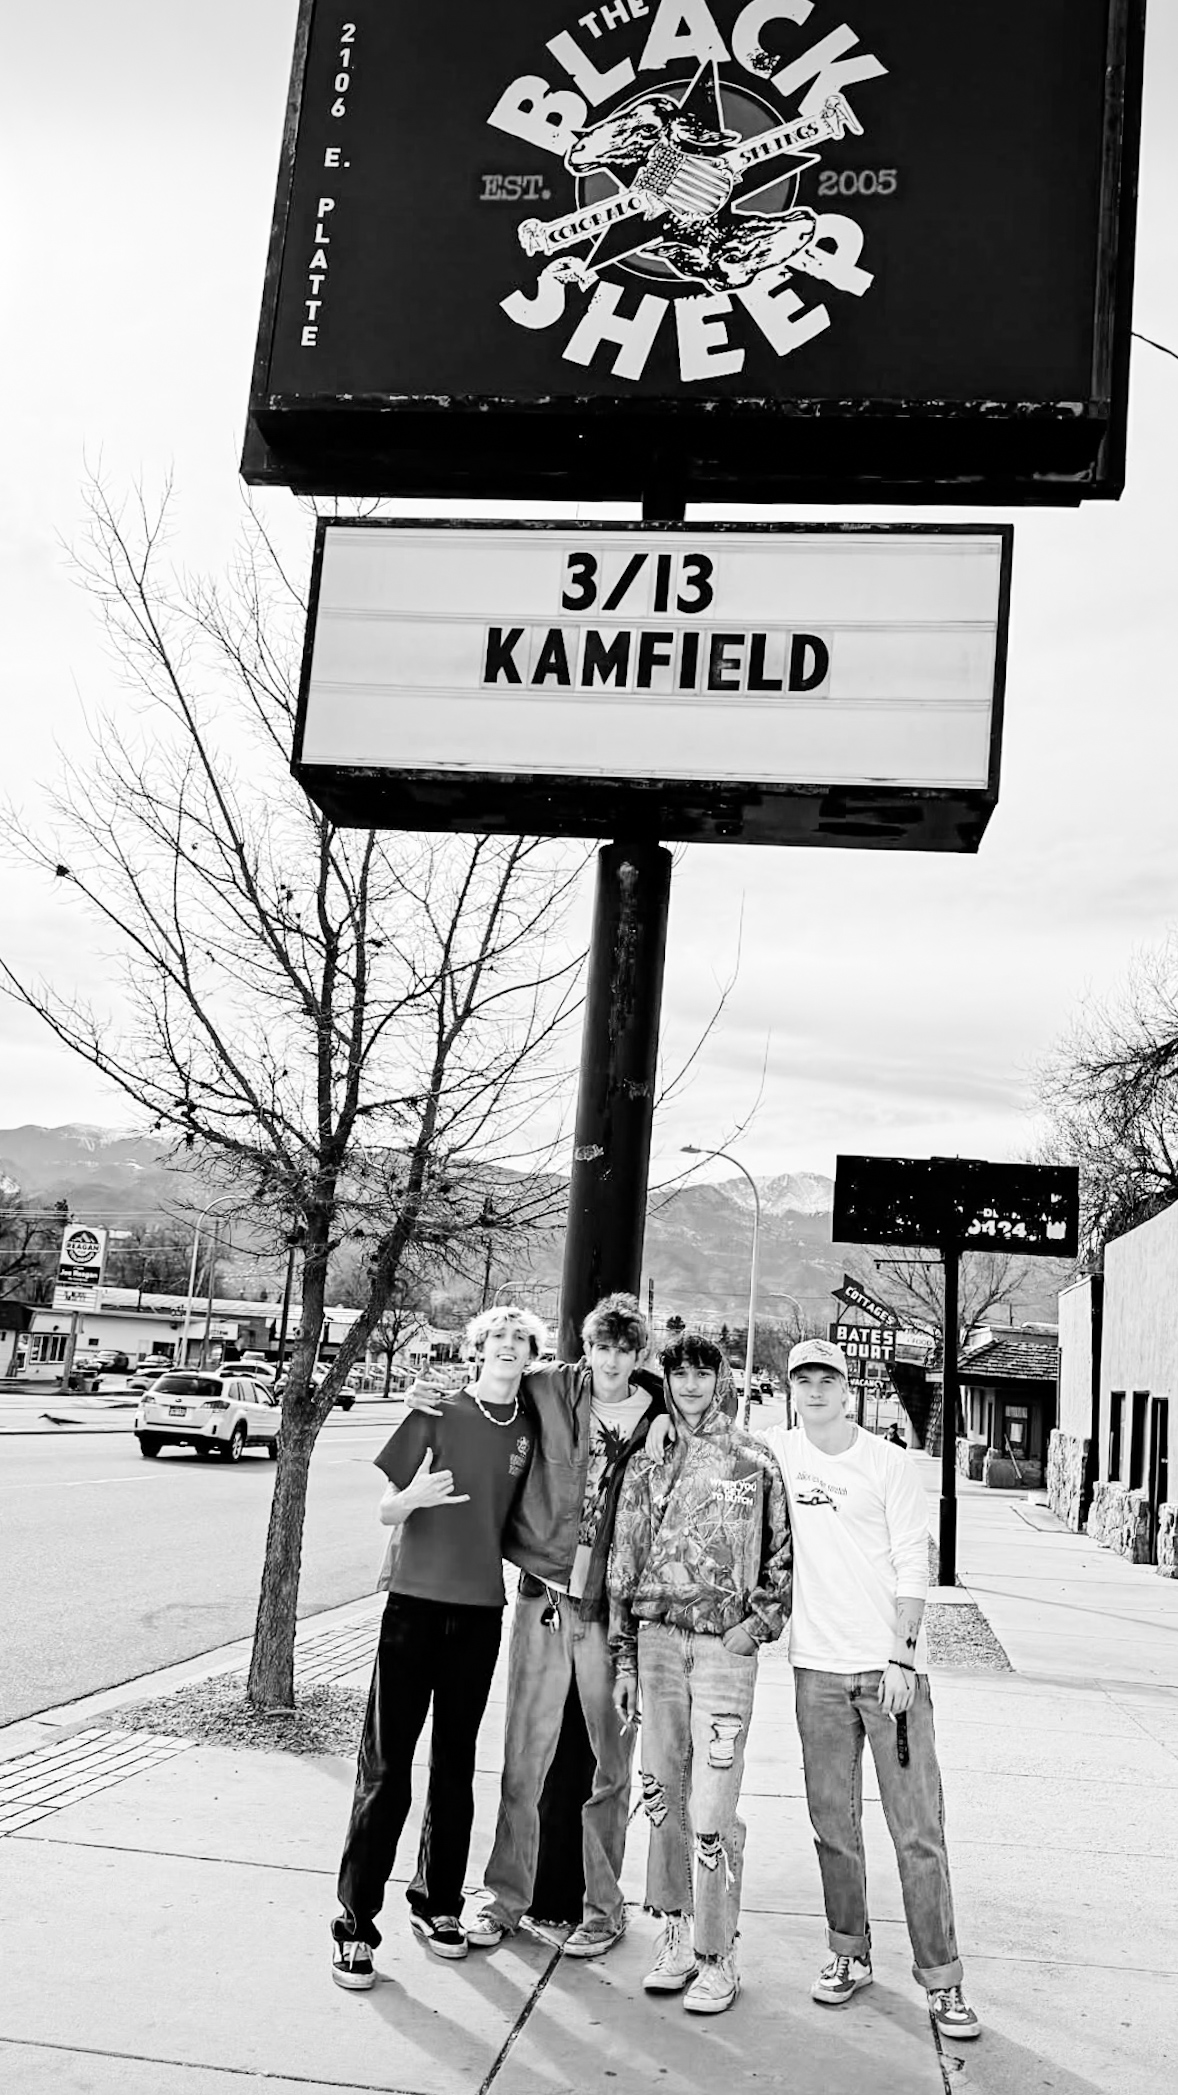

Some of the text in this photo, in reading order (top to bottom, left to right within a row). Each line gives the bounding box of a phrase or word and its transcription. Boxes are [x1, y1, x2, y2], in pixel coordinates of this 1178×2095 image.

[578, 0, 650, 39] THE
[487, 0, 889, 157] BLACK
[740, 123, 819, 164] SPRINGS
[301, 23, 356, 346] 2106 E. PLATTE
[480, 174, 551, 201] EST.
[818, 169, 898, 197] 2005
[549, 197, 642, 243] COLORADO
[499, 213, 875, 382] SHEEP
[562, 552, 714, 614] 3/13
[483, 627, 830, 692] KAMFIELD
[66, 1242, 99, 1251] REAGAN
[845, 1286, 895, 1325] COTTAGES
[837, 1326, 894, 1346] BATES
[850, 1379, 884, 1388] VACANCY
[711, 1491, 724, 1501] TO
[738, 1481, 757, 1492] YOU
